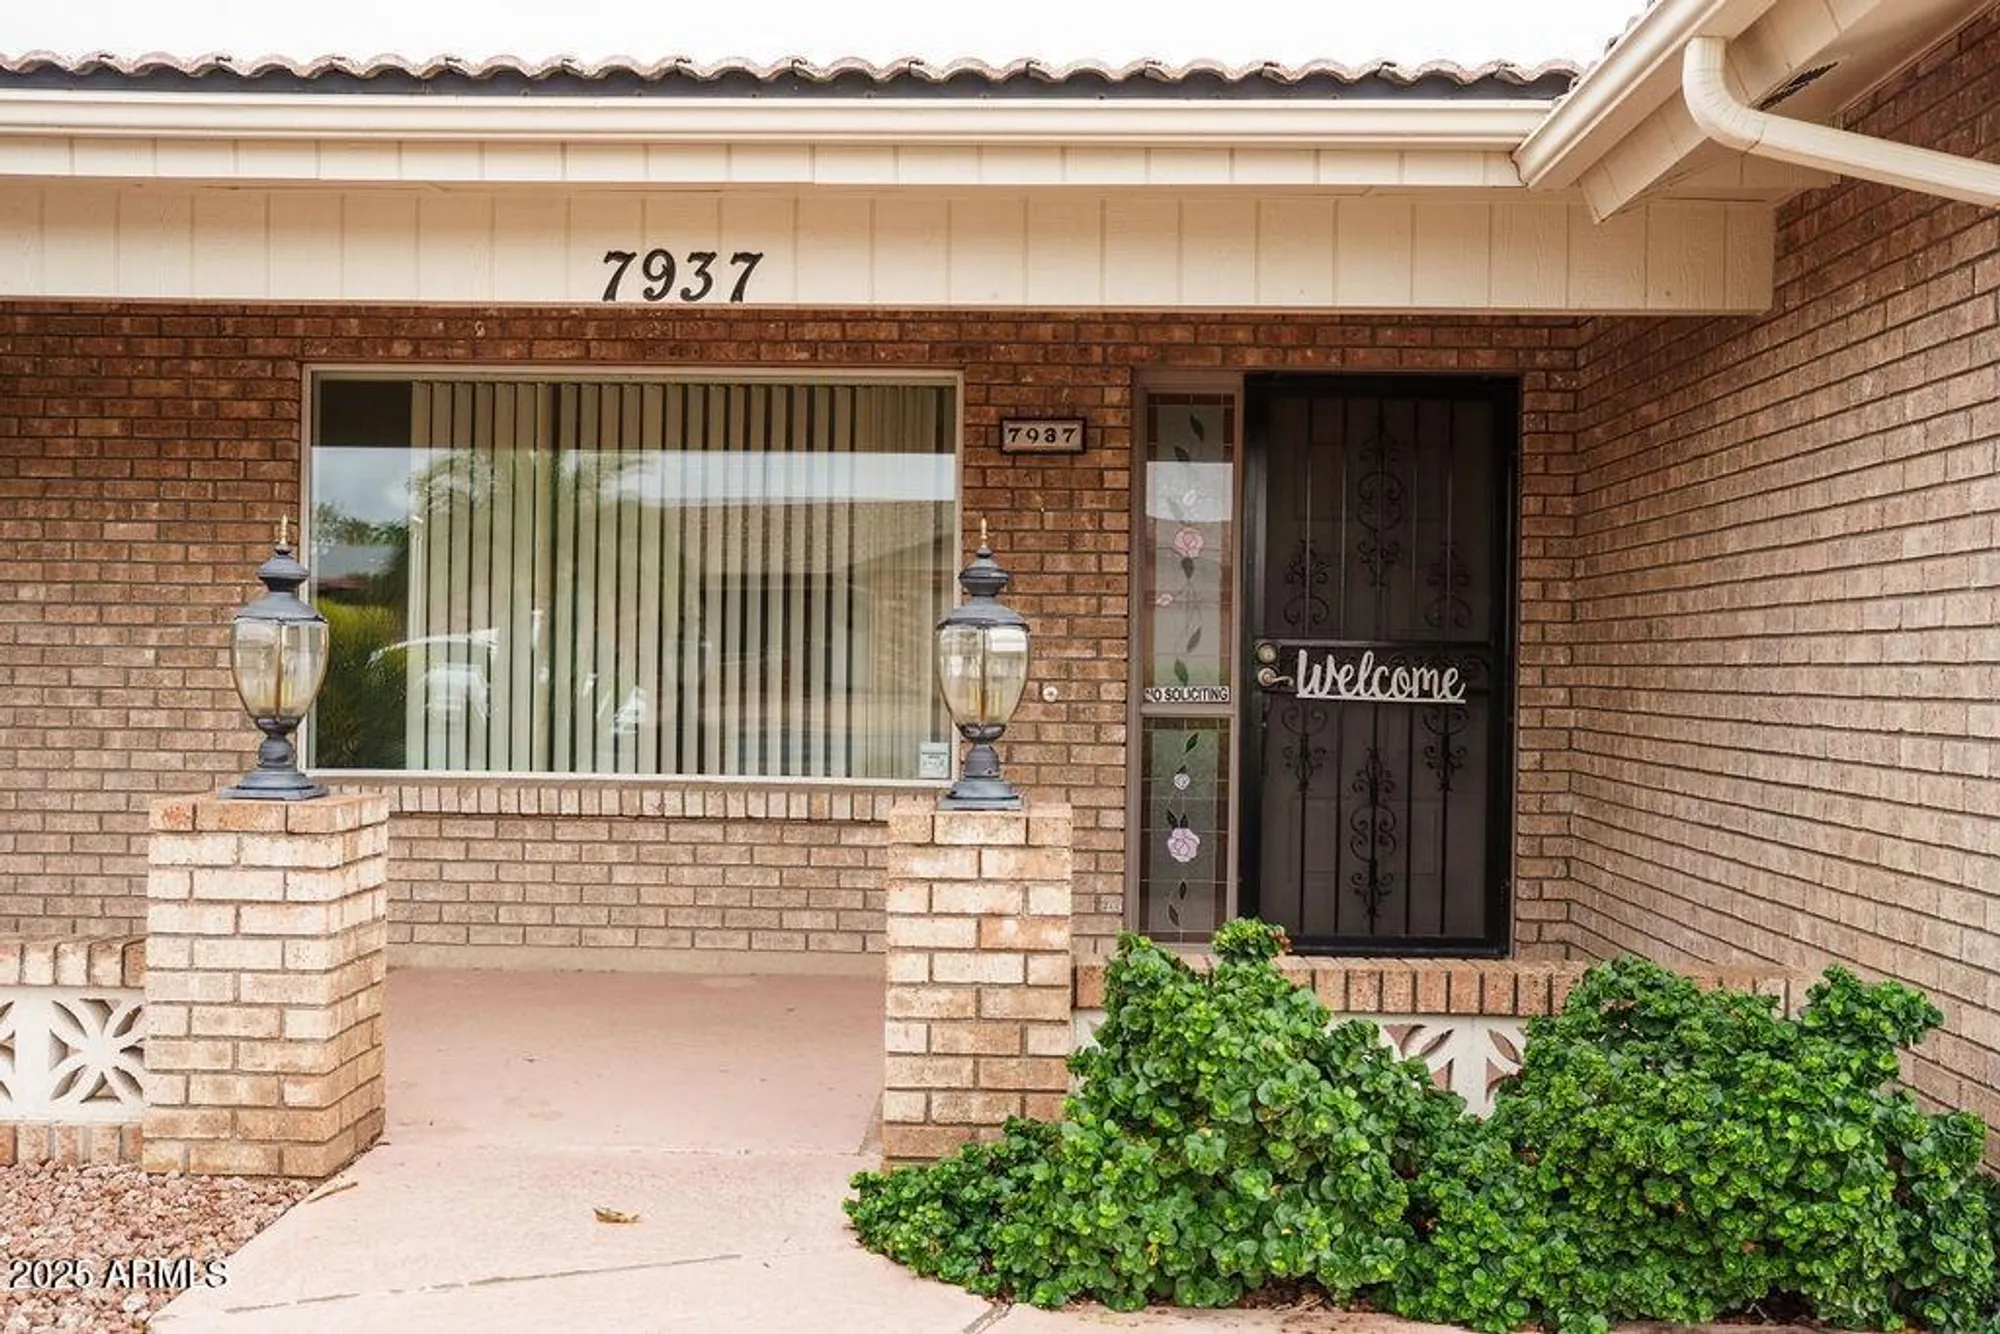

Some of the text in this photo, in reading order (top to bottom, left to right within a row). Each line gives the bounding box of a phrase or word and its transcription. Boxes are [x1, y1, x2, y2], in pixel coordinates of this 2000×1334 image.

[602, 248, 764, 303] 7937
[1164, 686, 1229, 701] SOLICITING
[1296, 649, 1467, 704] Welcome
